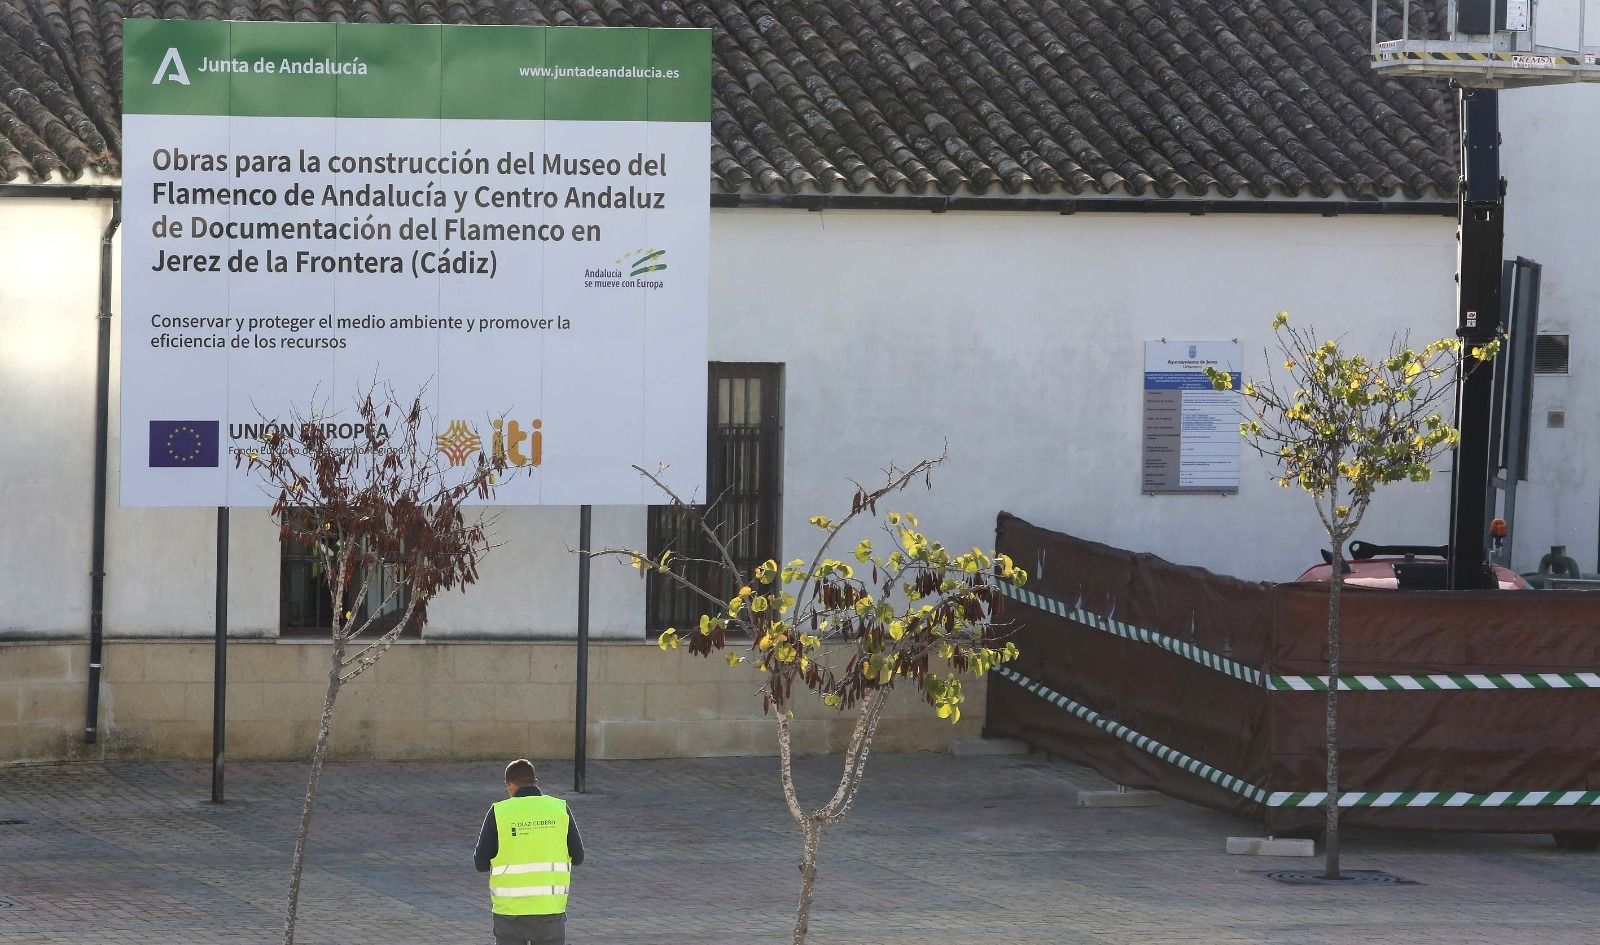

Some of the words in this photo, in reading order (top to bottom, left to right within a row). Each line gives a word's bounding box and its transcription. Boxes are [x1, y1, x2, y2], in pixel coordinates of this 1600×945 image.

[198, 57, 249, 74] Junta
[253, 57, 276, 74] de
[279, 57, 368, 76] Andalucía
[1518, 56, 1552, 64] REMSA
[519, 65, 680, 80] www.juntadeandalucia.es
[152, 148, 228, 172] Obras
[235, 155, 291, 178] para
[299, 149, 321, 173] la
[327, 147, 490, 176] construcción
[496, 151, 536, 176] del
[542, 153, 621, 176] Museo
[627, 152, 667, 177] del
[153, 181, 278, 207] Flamenco
[284, 182, 315, 207] de
[321, 181, 447, 208] Andalucía
[453, 190, 469, 213] y
[475, 185, 559, 209] Centro
[564, 186, 666, 210] Andaluz
[152, 214, 184, 239] de
[191, 213, 392, 241] Documentación
[399, 216, 438, 241] del
[445, 217, 565, 242] Flamenco
[571, 224, 601, 242] en
[151, 250, 221, 273] Jerez
[227, 248, 259, 273] de
[267, 249, 288, 273] la
[296, 250, 404, 275] Frontera
[411, 247, 497, 280] (Cádiz)
[584, 280, 593, 288] se
[594, 280, 620, 288] mueve
[621, 280, 635, 288] con
[636, 279, 664, 290] Europa
[151, 314, 233, 329] Conservar
[235, 317, 245, 333] y
[248, 315, 316, 333] proteger
[318, 313, 336, 329] el
[337, 314, 386, 329] medio
[389, 314, 463, 330] ambiente
[466, 318, 476, 333] y
[479, 318, 555, 333] promover
[557, 315, 571, 330] la
[150, 332, 226, 349] eficiencia
[230, 333, 250, 349] de
[254, 333, 277, 349] los
[280, 337, 347, 349] recursos
[229, 419, 294, 440] UNIÓN
[261, 446, 299, 456] Euopo
[317, 446, 364, 455] esarrollo
[492, 419, 542, 466] iti
